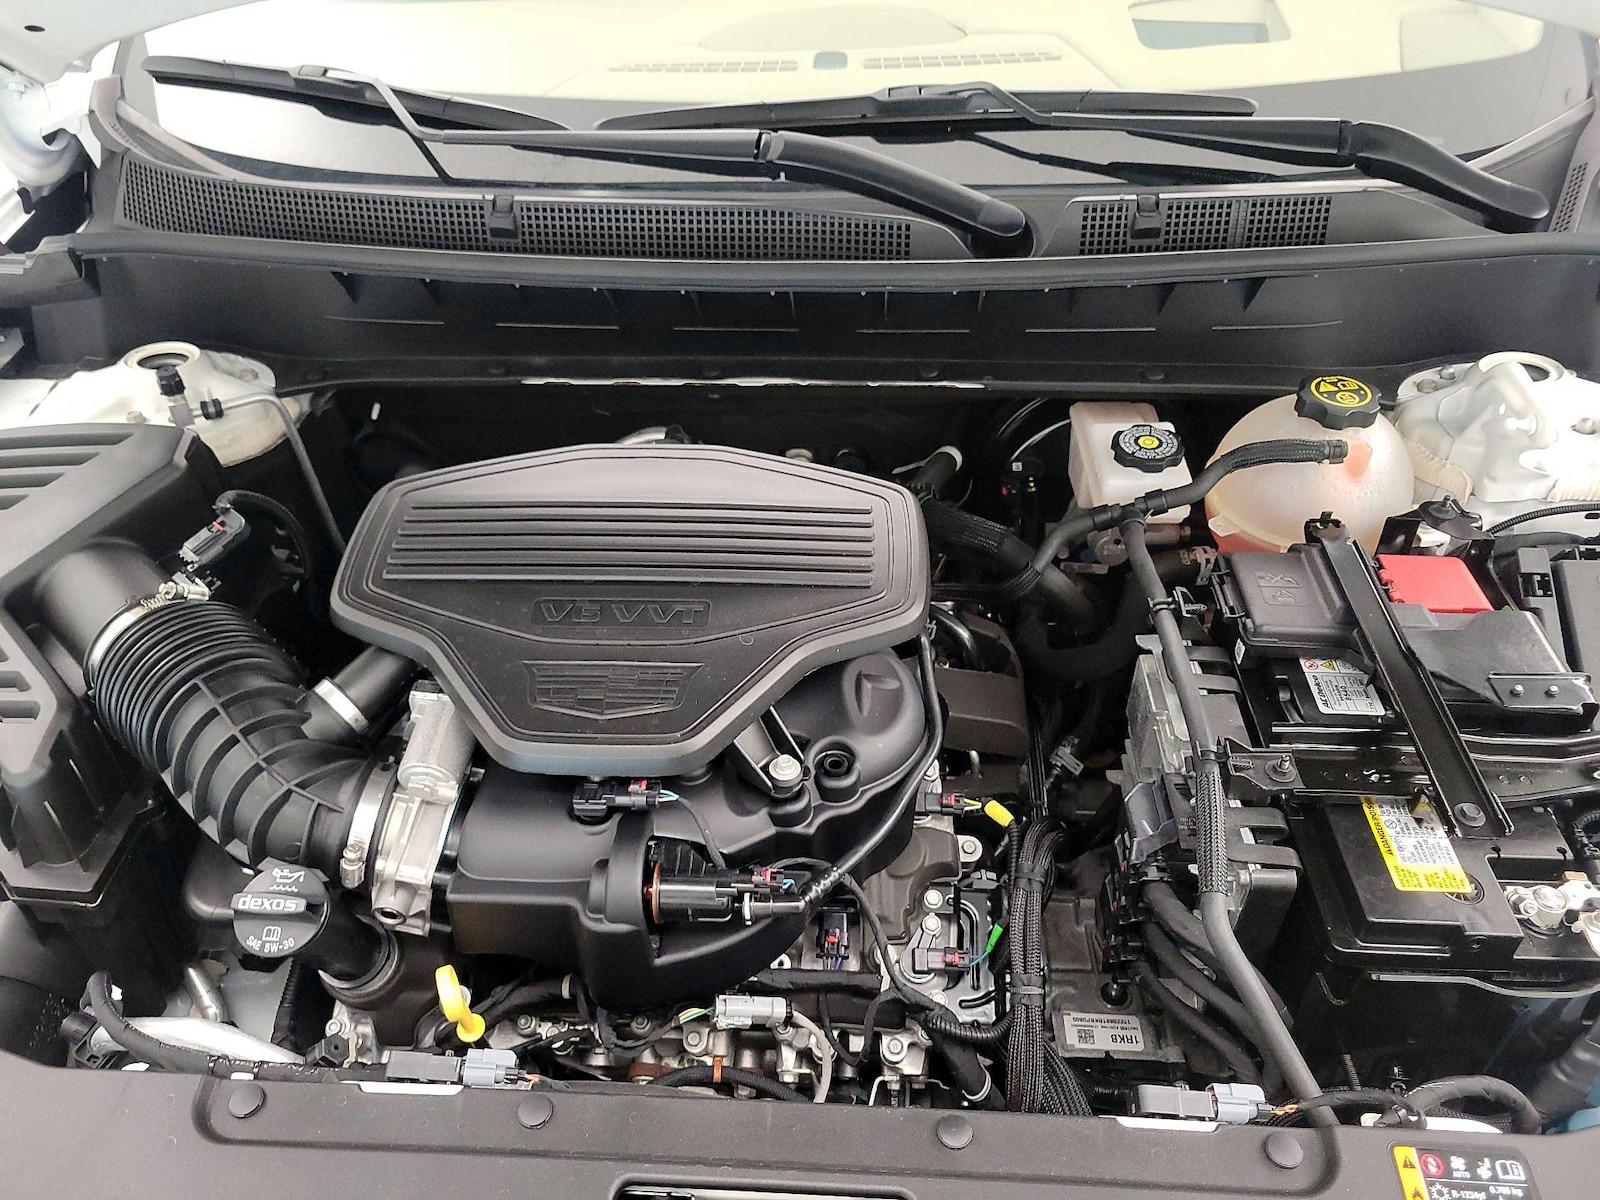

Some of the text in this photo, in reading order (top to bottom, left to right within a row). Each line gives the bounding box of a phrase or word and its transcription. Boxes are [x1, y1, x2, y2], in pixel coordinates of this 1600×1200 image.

[541, 602, 704, 624] V6 VVT
[237, 894, 298, 911] dexos
[246, 935, 263, 951] SAE
[1453, 1171, 1471, 1179] AUTO
